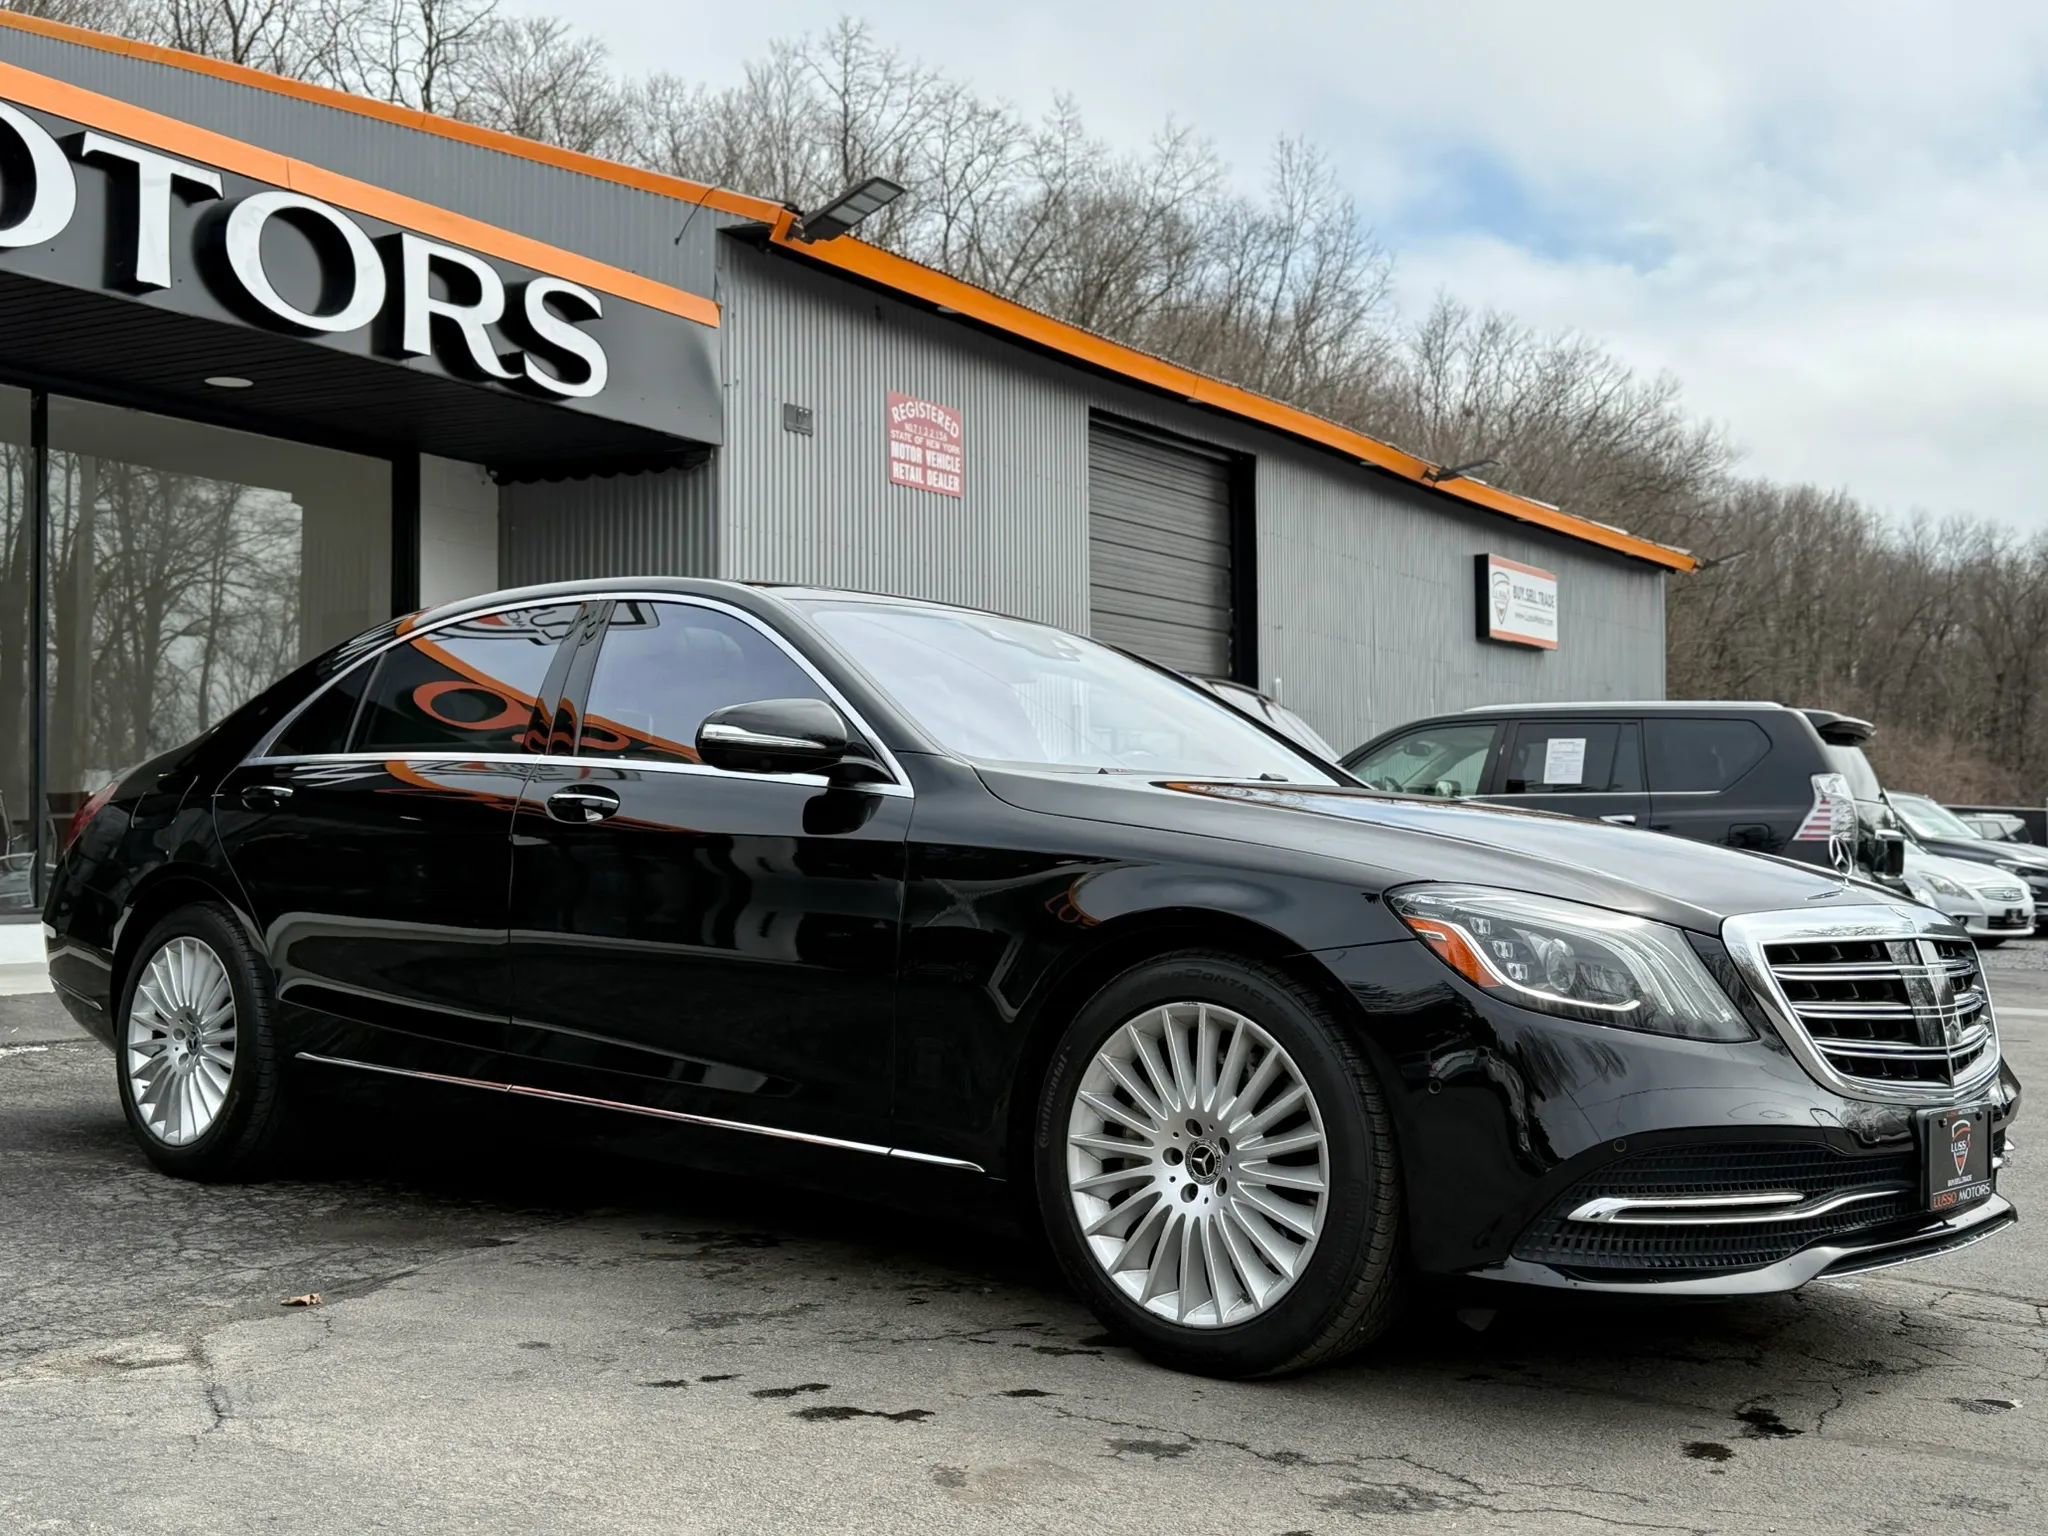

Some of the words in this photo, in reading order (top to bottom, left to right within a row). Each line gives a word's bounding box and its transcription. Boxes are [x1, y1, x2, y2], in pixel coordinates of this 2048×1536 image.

[891, 401, 959, 438] REGISTERED
[890, 429, 912, 443] STATE
[914, 435, 924, 445] OF
[926, 439, 940, 449] NEW
[942, 443, 960, 454] YORK
[890, 440, 922, 464] MOTOR
[926, 449, 960, 474] VEHICLE
[892, 461, 924, 484] RETAIL
[926, 469, 960, 493] DEALER
[1933, 1191, 1957, 1209] LUSSO
[1958, 1182, 1991, 1201] MOTORS
